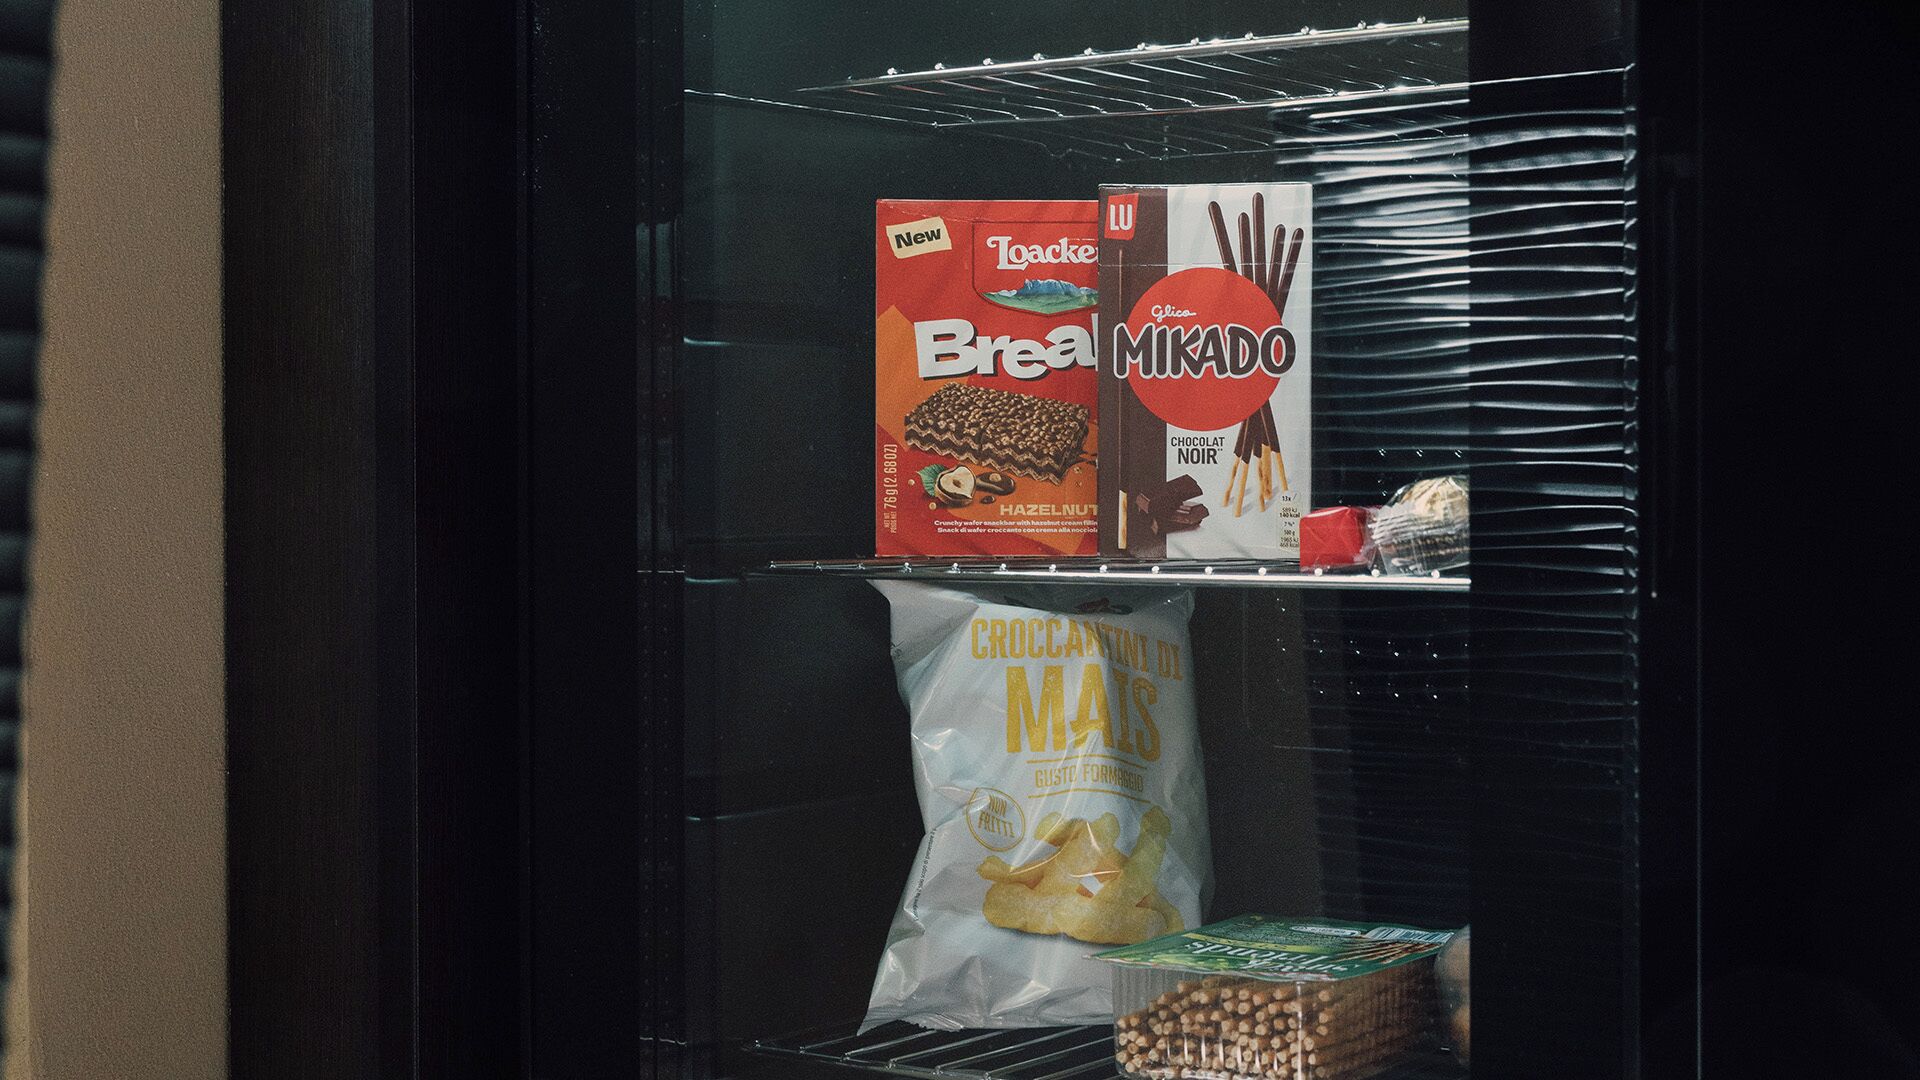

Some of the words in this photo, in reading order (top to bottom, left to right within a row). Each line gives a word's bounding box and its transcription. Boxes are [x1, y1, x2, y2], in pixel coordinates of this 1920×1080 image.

[1110, 203, 1133, 231] LU
[894, 228, 941, 249] New
[986, 235, 1099, 271] Loacke
[914, 312, 1099, 381] Brea
[1113, 322, 1297, 379] MIKADO
[1170, 436, 1226, 447] CHOCOLAT
[1000, 504, 1098, 516] HAZELNUT
[970, 617, 1150, 673] CROCCANTINI
[1157, 639, 1184, 682] DI
[1005, 663, 1162, 763] MAIS
[1035, 765, 1077, 789] GUSTO
[1082, 763, 1144, 793] FORMAGGIO
[989, 794, 1008, 818] NON
[978, 811, 1016, 838] FRITTI
